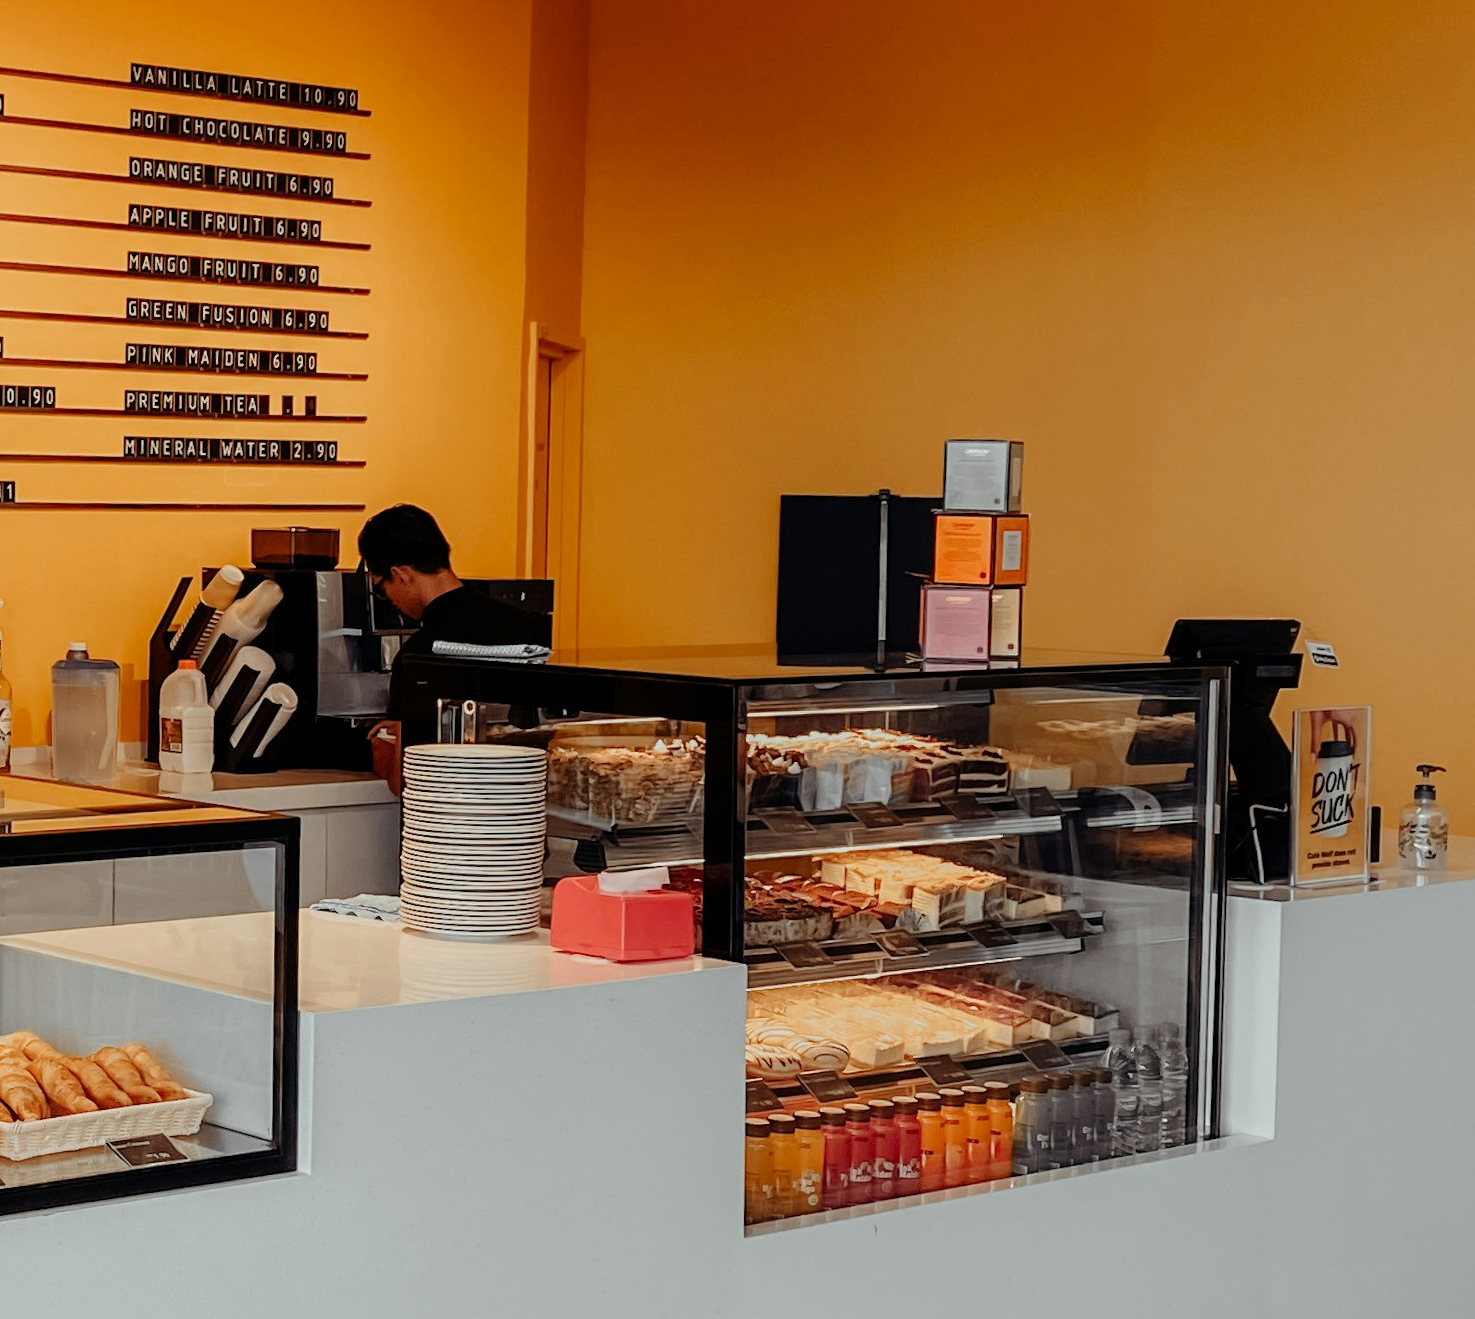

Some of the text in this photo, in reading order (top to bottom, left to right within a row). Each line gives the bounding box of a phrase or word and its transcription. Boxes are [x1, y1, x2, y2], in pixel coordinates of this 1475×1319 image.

[131, 66, 356, 106] VANILLA LATTE 10.90
[131, 112, 345, 149] HOT CHOCOLATE 9.90
[131, 160, 332, 195] ORANGE FRUIT 6.90
[129, 207, 319, 237] APPLE FRUIT 6.90
[128, 255, 318, 283] MANGO FRUIT 6.90
[127, 300, 327, 328] GREEN FUSION 6.90
[126, 346, 315, 370] PINK MAIDEN 6.90
[125, 392, 257, 412] PREMIUM TEA
[124, 439, 336, 459] MINERAL WATER 2.90
[1312, 763, 1361, 799] DON'T
[1311, 793, 1354, 828] SUCK
